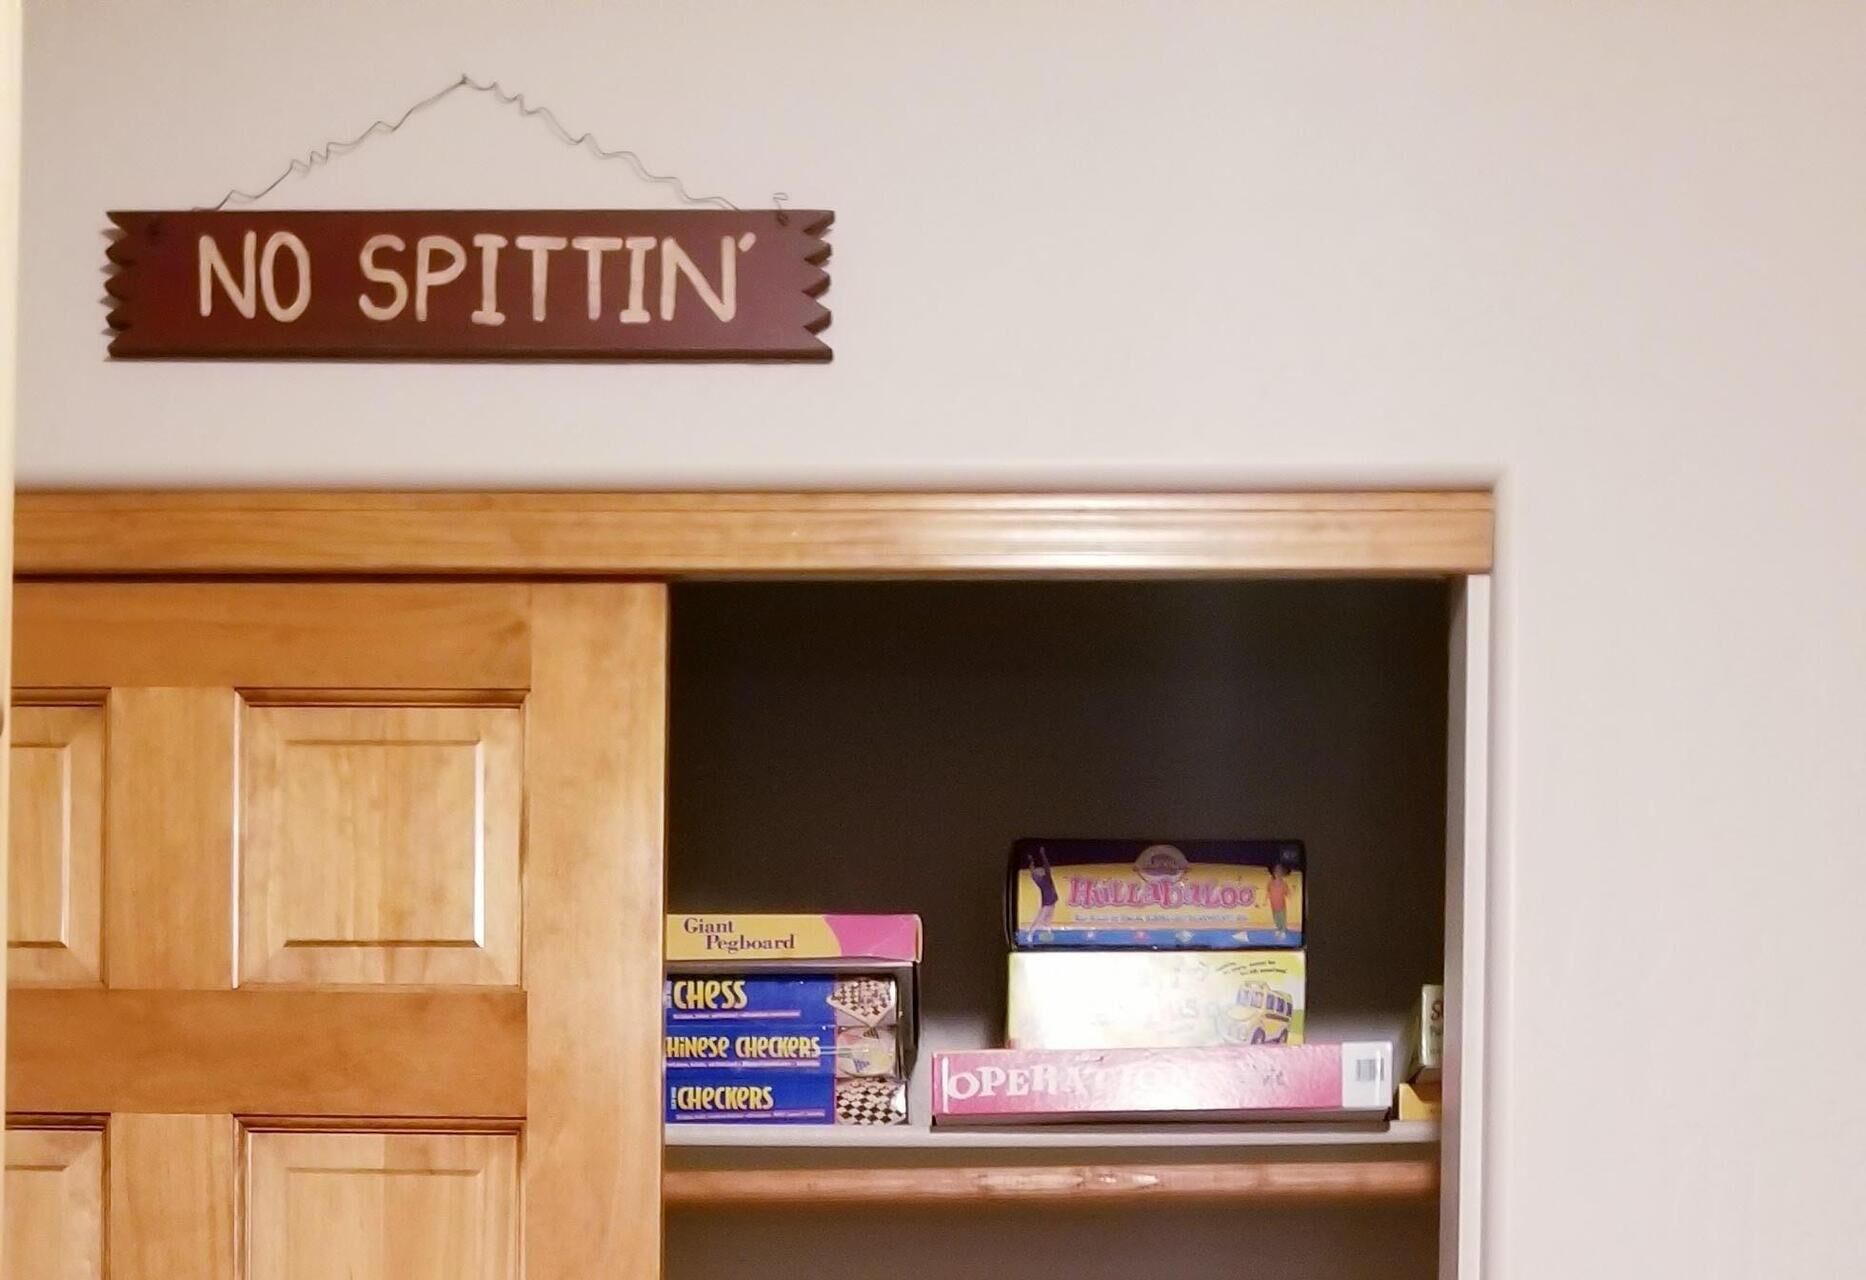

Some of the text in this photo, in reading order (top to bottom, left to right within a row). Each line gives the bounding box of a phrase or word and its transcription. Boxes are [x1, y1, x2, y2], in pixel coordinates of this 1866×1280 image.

[199, 230, 757, 326] NO SPITTIN'
[683, 917, 734, 935] Giant
[705, 934, 795, 953] Pegboard
